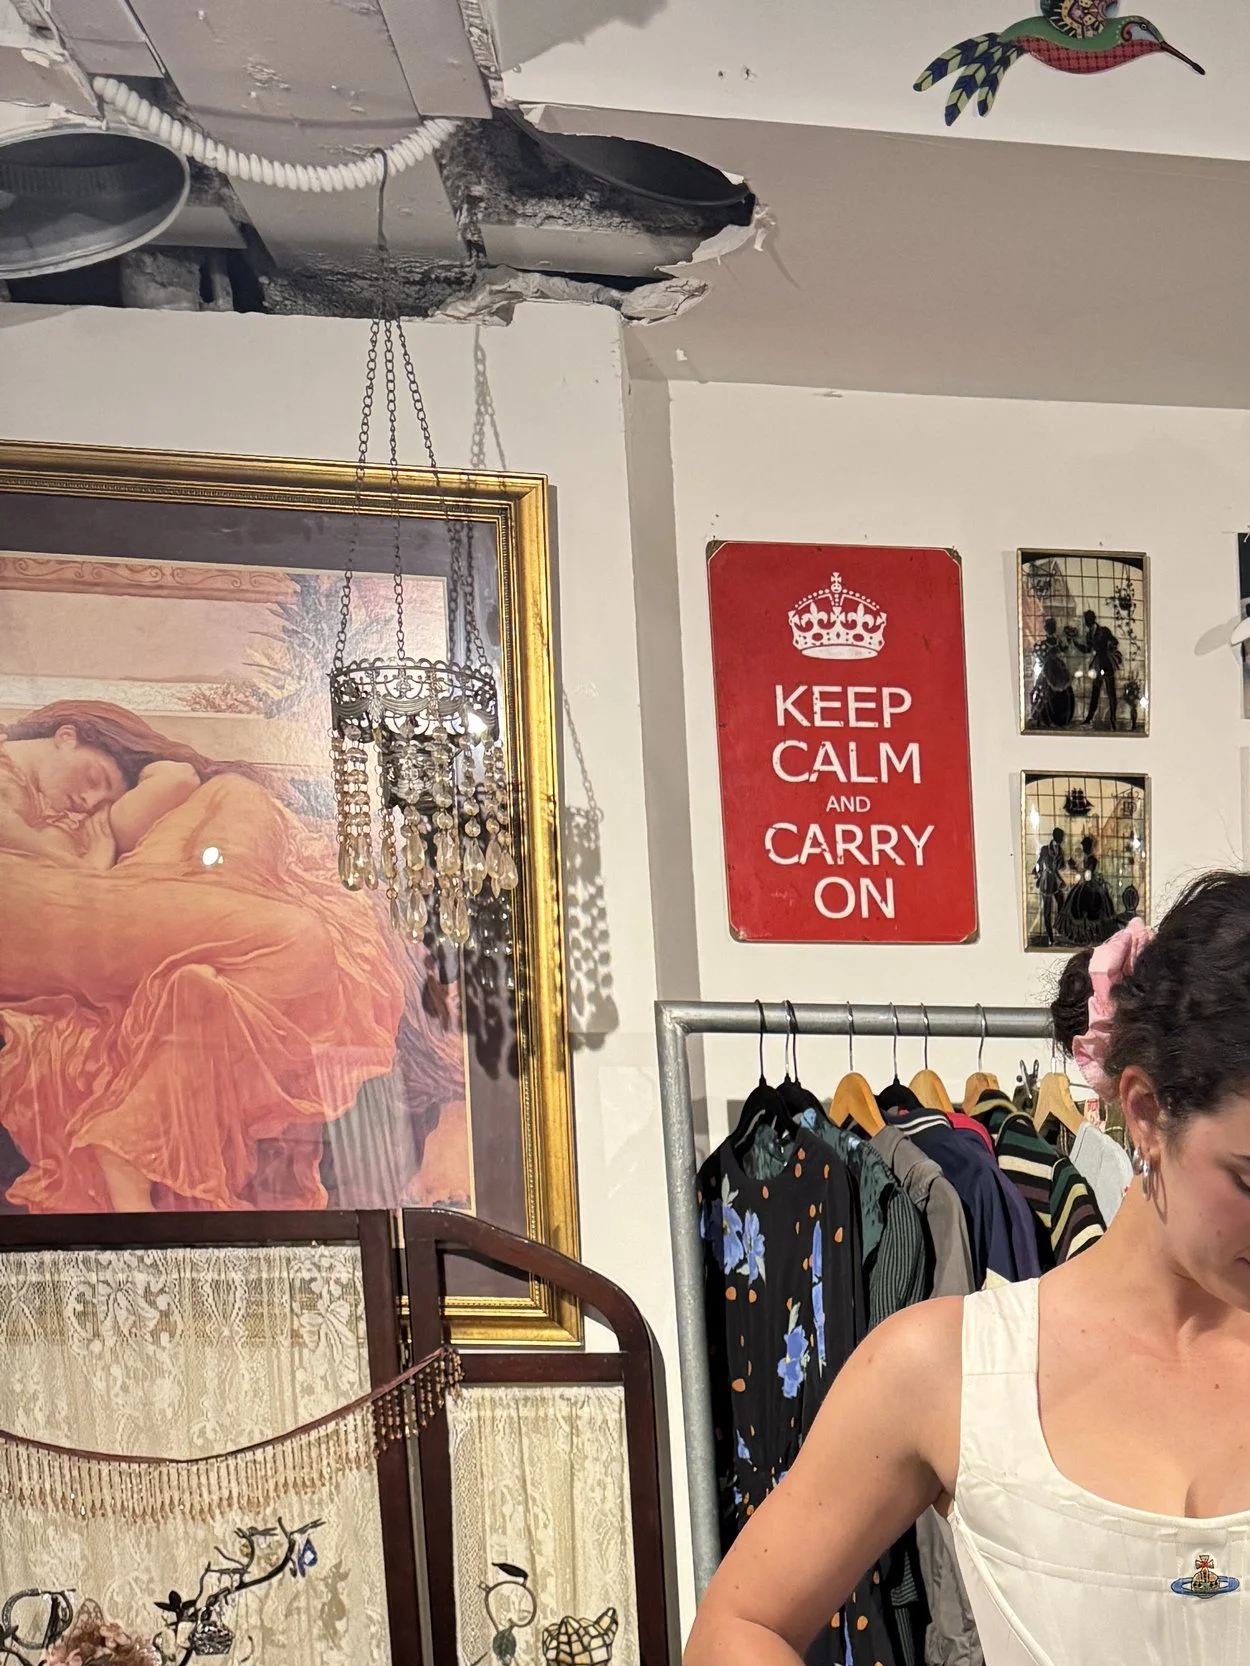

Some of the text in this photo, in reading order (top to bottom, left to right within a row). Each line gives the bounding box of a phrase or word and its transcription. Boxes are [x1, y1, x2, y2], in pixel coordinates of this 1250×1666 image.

[775, 684, 912, 728] KEEP
[772, 741, 921, 784] CALM
[826, 795, 871, 813] AND
[764, 822, 935, 866] CARRY
[813, 876, 895, 919] ON
